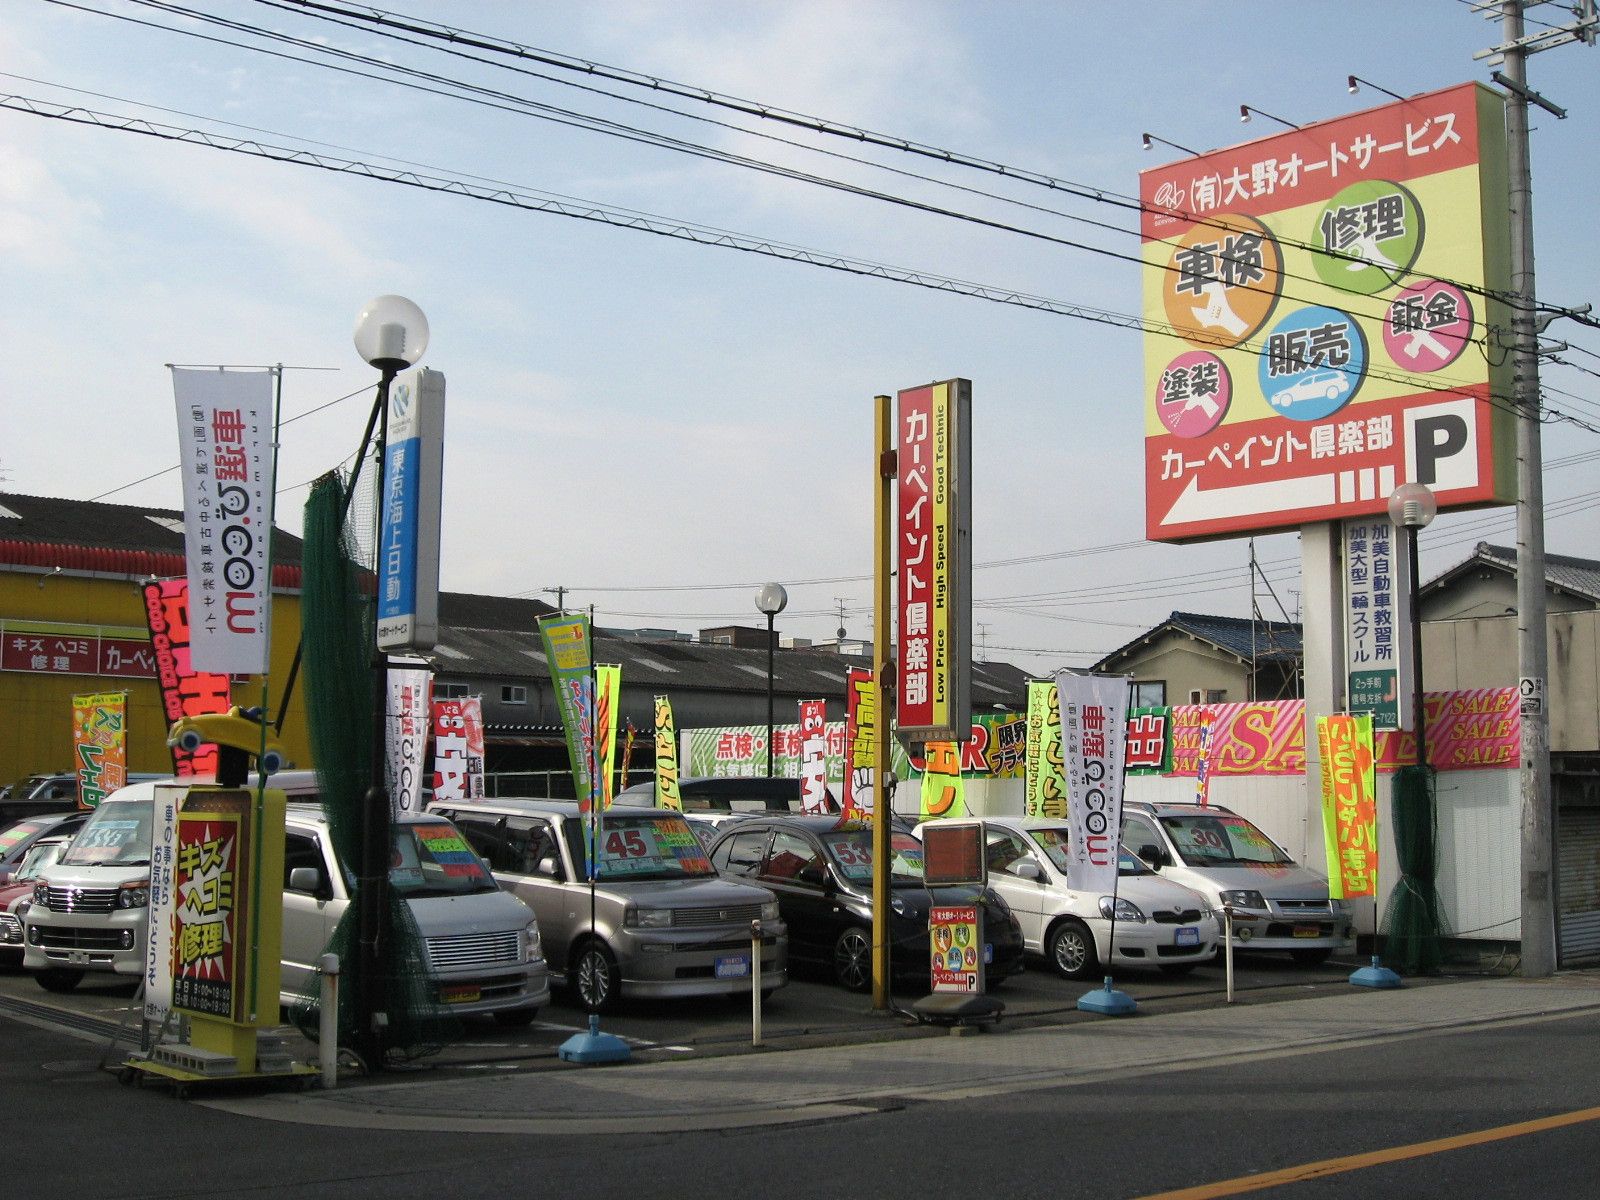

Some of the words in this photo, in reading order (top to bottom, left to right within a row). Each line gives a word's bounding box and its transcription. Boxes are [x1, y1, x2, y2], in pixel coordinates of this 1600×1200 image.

[1321, 194, 1405, 250] 修理
[1175, 232, 1265, 295] 車検
[1391, 290, 1459, 336] 鈑金
[1269, 321, 1350, 378] 販売
[1163, 361, 1220, 404] 塗装
[935, 404, 945, 463] Technic
[1161, 414, 1394, 481] カーペイント倶楽部
[1414, 413, 1468, 485] P
[935, 466, 945, 505] Good
[386, 448, 405, 602] 東京海上日動
[935, 524, 946, 570] Speed
[905, 408, 930, 705] カーペイント倶楽部
[144, 584, 167, 633] GOOD
[935, 575, 947, 609] High
[1349, 526, 1370, 663] 加美大型二輪スクール
[1371, 523, 1393, 661] 加美自動車教習所
[12, 637, 45, 652] キズ
[55, 640, 89, 655] ヘコミ
[31, 654, 70, 671] 修理
[935, 629, 945, 668] Price
[935, 672, 945, 704] Low
[1451, 694, 1511, 714] SALE
[1126, 714, 1166, 768] 出
[1452, 719, 1513, 740] SALE
[1452, 745, 1514, 765] SALE
[605, 830, 647, 859] 45
[833, 841, 873, 865] 53
[1190, 824, 1222, 848] 30
[179, 837, 225, 880] キズ
[187, 871, 233, 915] ヘコミ
[179, 920, 224, 966] 修理
[968, 976, 975, 989] P
